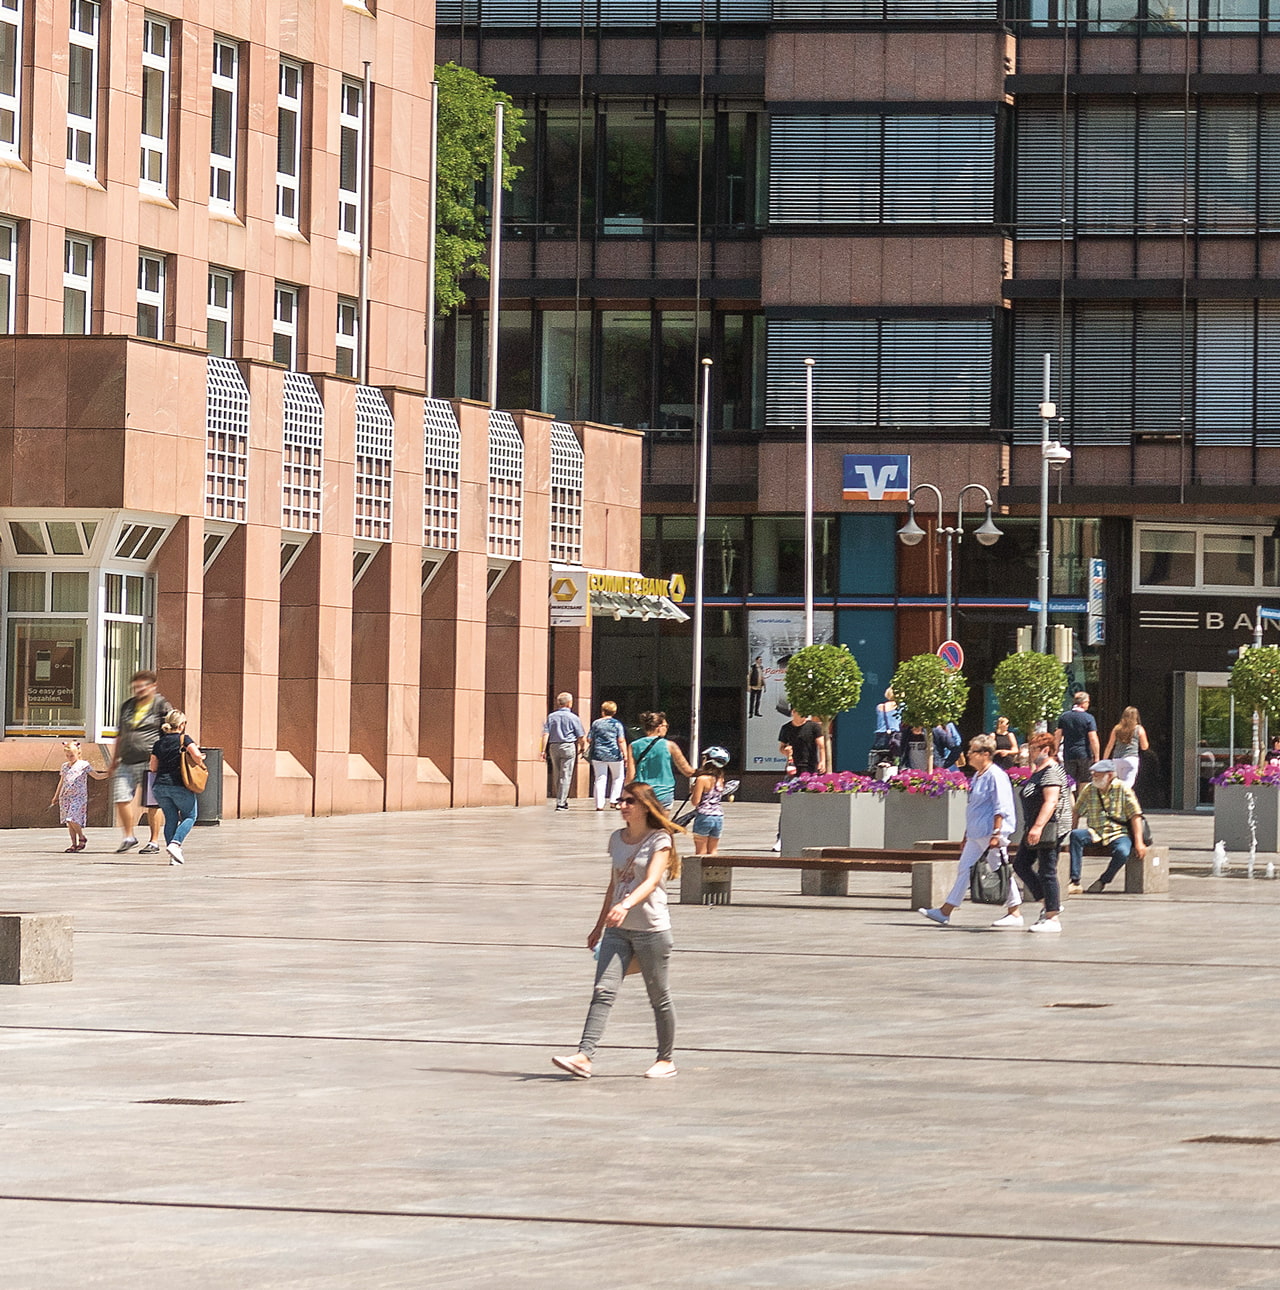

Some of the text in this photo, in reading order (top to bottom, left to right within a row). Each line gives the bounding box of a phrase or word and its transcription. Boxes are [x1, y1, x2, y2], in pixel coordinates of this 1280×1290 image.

[589, 574, 670, 597] COMMERZBANK
[28, 687, 74, 696] So easy geht
[28, 694, 63, 702] bezahlen.
